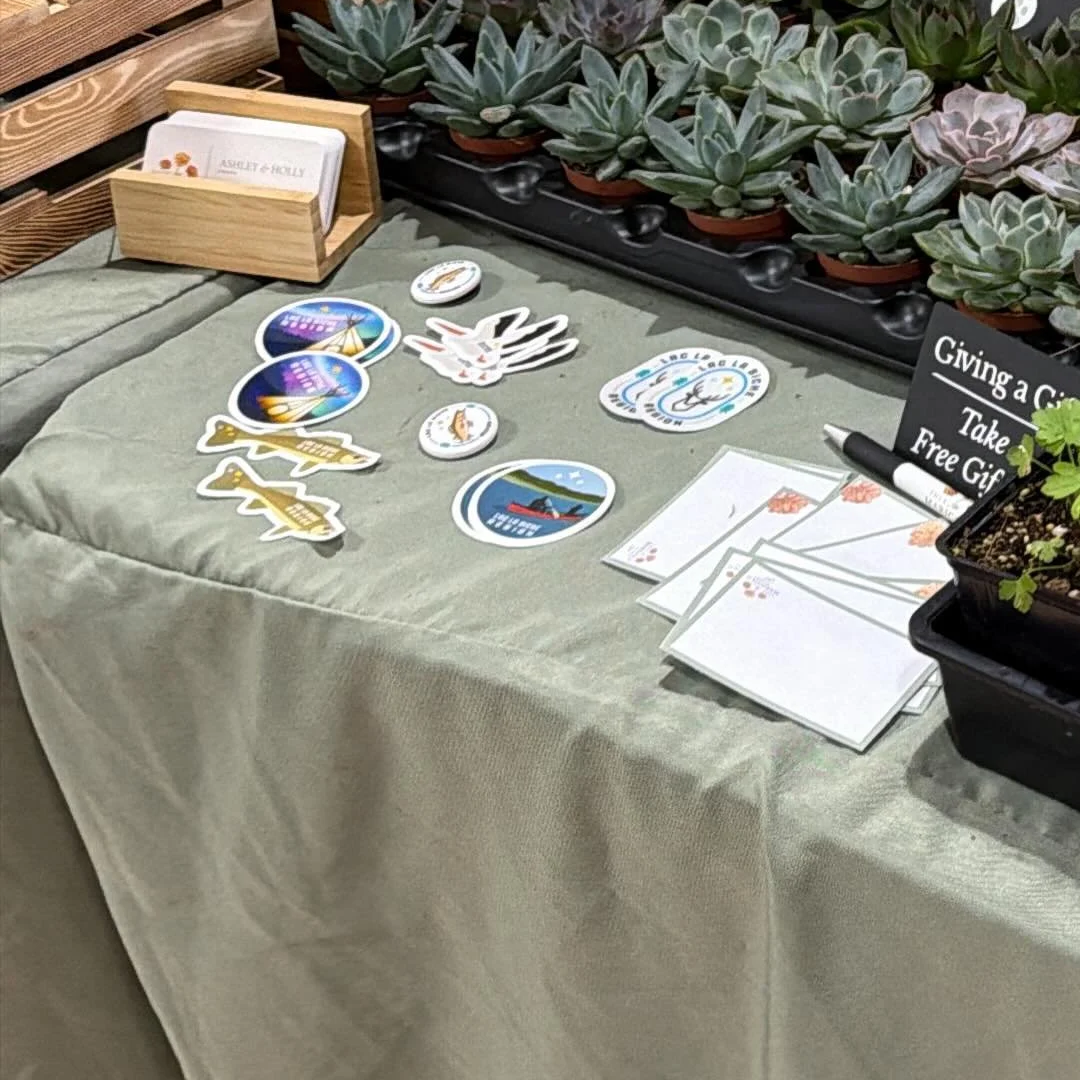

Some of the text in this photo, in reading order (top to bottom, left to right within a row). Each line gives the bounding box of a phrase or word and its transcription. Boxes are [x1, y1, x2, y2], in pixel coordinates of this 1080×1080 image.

[219, 159, 257, 172] ASHLEY
[271, 165, 305, 178] HOLLY
[699, 360, 726, 371] LAC
[934, 335, 1013, 400] Giving
[1013, 380, 1029, 403] a
[910, 427, 960, 472] Free
[958, 406, 1010, 455] Take
